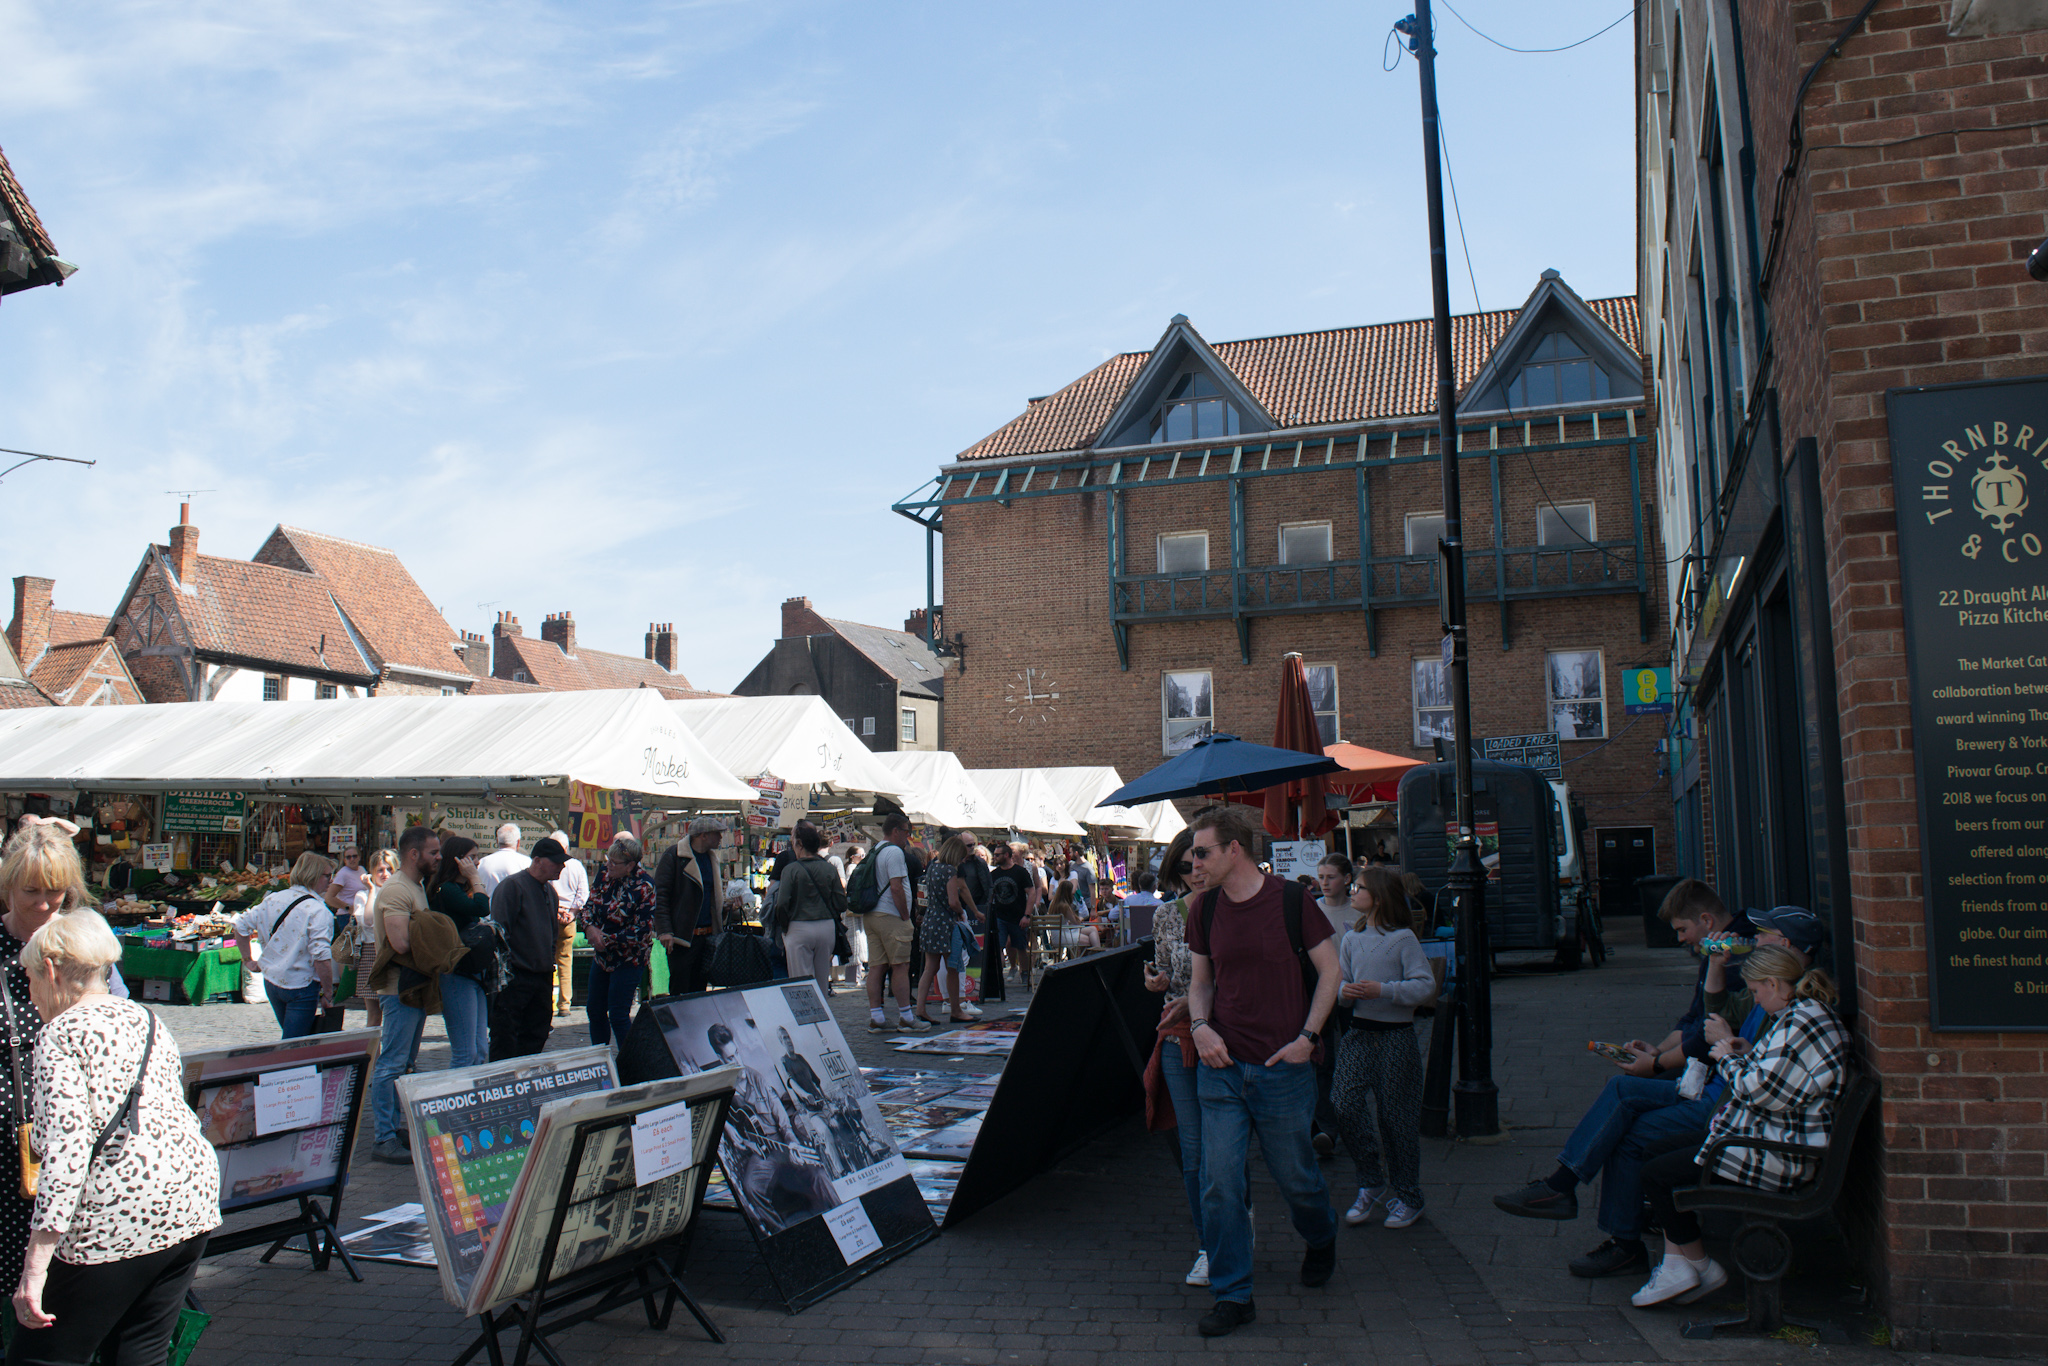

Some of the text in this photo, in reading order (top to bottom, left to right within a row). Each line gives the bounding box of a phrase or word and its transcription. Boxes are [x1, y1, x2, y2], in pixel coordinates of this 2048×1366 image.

[1922, 421, 2048, 525] THORNBRI
[1961, 533, 2042, 563] & CO
[1939, 590, 1960, 606] 22
[1963, 587, 2027, 606] Draught
[1959, 610, 1999, 626] Pizza
[1957, 655, 2048, 670] The Market Cat
[1932, 684, 2012, 698] collaboration
[1936, 712, 1974, 725] award
[1977, 710, 2026, 724] winning
[1488, 735, 1554, 749] LOADED FRIES
[1956, 736, 2048, 752] Brewery & York
[642, 746, 689, 787] Market
[1947, 765, 1992, 778] Pivovar
[1994, 763, 2033, 778] Group.
[179, 798, 234, 807] GREENGROCERS
[571, 782, 623, 810] LOVE
[783, 793, 805, 810] arket
[1942, 791, 2046, 804] 2018 we focus on
[447, 807, 495, 820] Sheila's
[448, 822, 463, 832] Shop
[1955, 818, 2045, 831] beers from our
[1970, 845, 2014, 858] offered
[1948, 873, 2003, 886] selection
[2006, 872, 2036, 884] from
[1961, 900, 2004, 912] friends
[2007, 899, 2037, 912] from
[1959, 926, 2047, 942] globe. Our aim
[1950, 955, 1970, 967] the
[1973, 954, 2007, 966] finest
[2010, 954, 2042, 966] hand
[2014, 981, 2024, 994] &
[824, 1054, 847, 1076] HALT
[287, 1084, 300, 1092] each
[343, 1064, 359, 1108] AUDREY
[420, 1092, 478, 1116] PERIODIC
[478, 1084, 514, 1103] TABLE
[515, 1082, 531, 1095] OF
[532, 1074, 555, 1091] THE
[556, 1065, 608, 1087] ELEMENTS
[286, 1111, 295, 1119] £10
[310, 1068, 346, 1166] BREAKFAST AT
[653, 1124, 673, 1136] £6 each
[662, 1156, 670, 1165] £10
[858, 1169, 874, 1180] GREAT
[670, 1174, 680, 1203] ACE
[460, 1243, 482, 1257] Symbol
